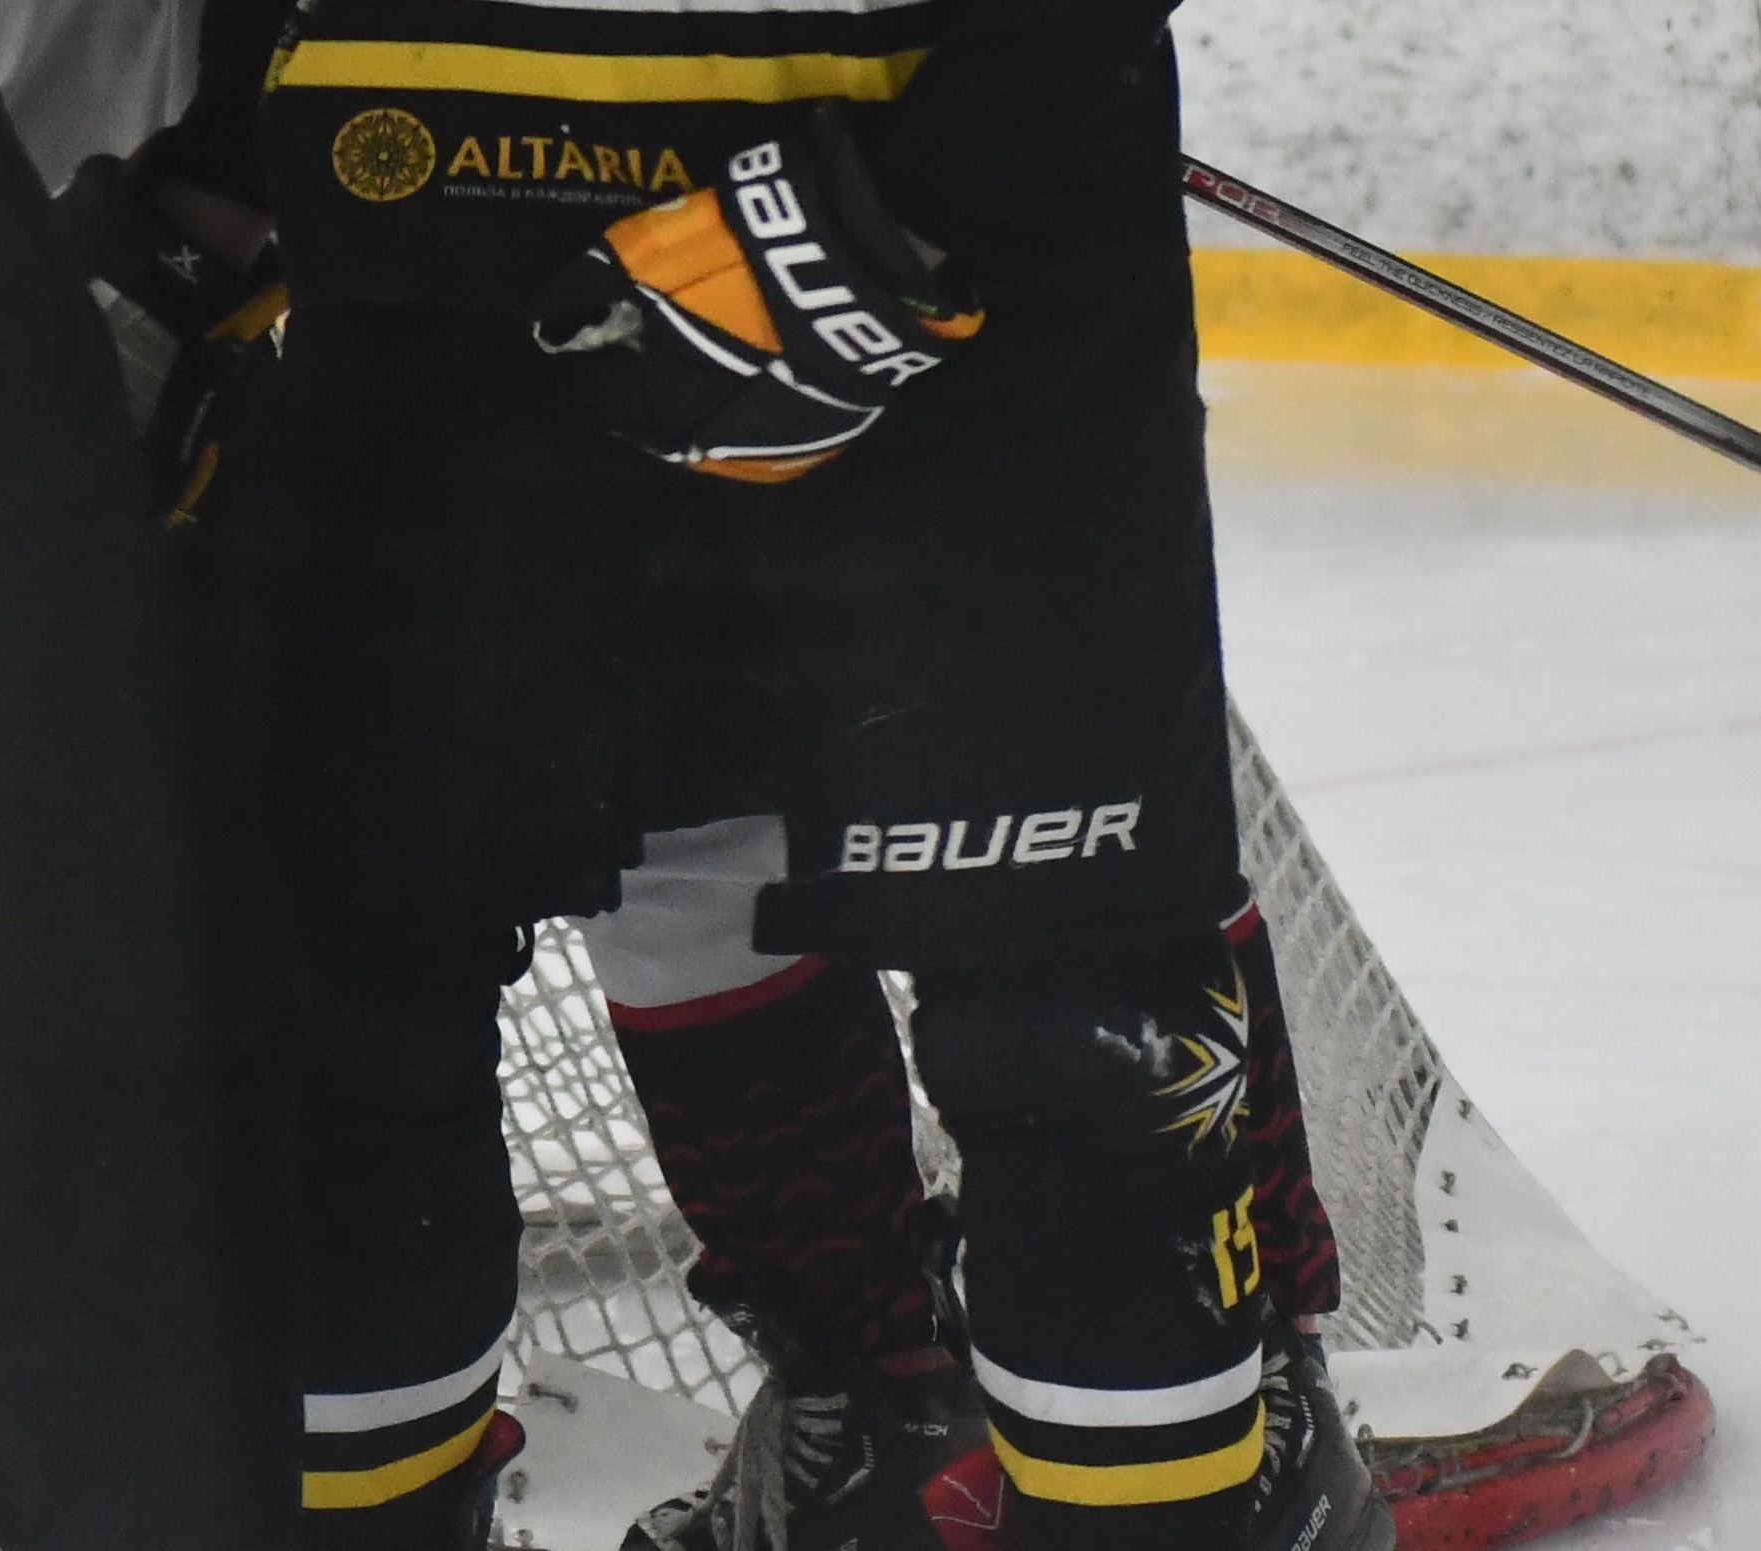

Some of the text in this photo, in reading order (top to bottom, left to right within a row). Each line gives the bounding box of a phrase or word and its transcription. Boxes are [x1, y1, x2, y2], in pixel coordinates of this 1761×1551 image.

[447, 135, 692, 193] ALTARIA
[1181, 163, 1281, 226] POR
[728, 141, 942, 387] BAUER
[1343, 243, 1375, 266] FEEL
[841, 795, 1143, 873] BAUER
[1212, 1184, 1262, 1309] 15
